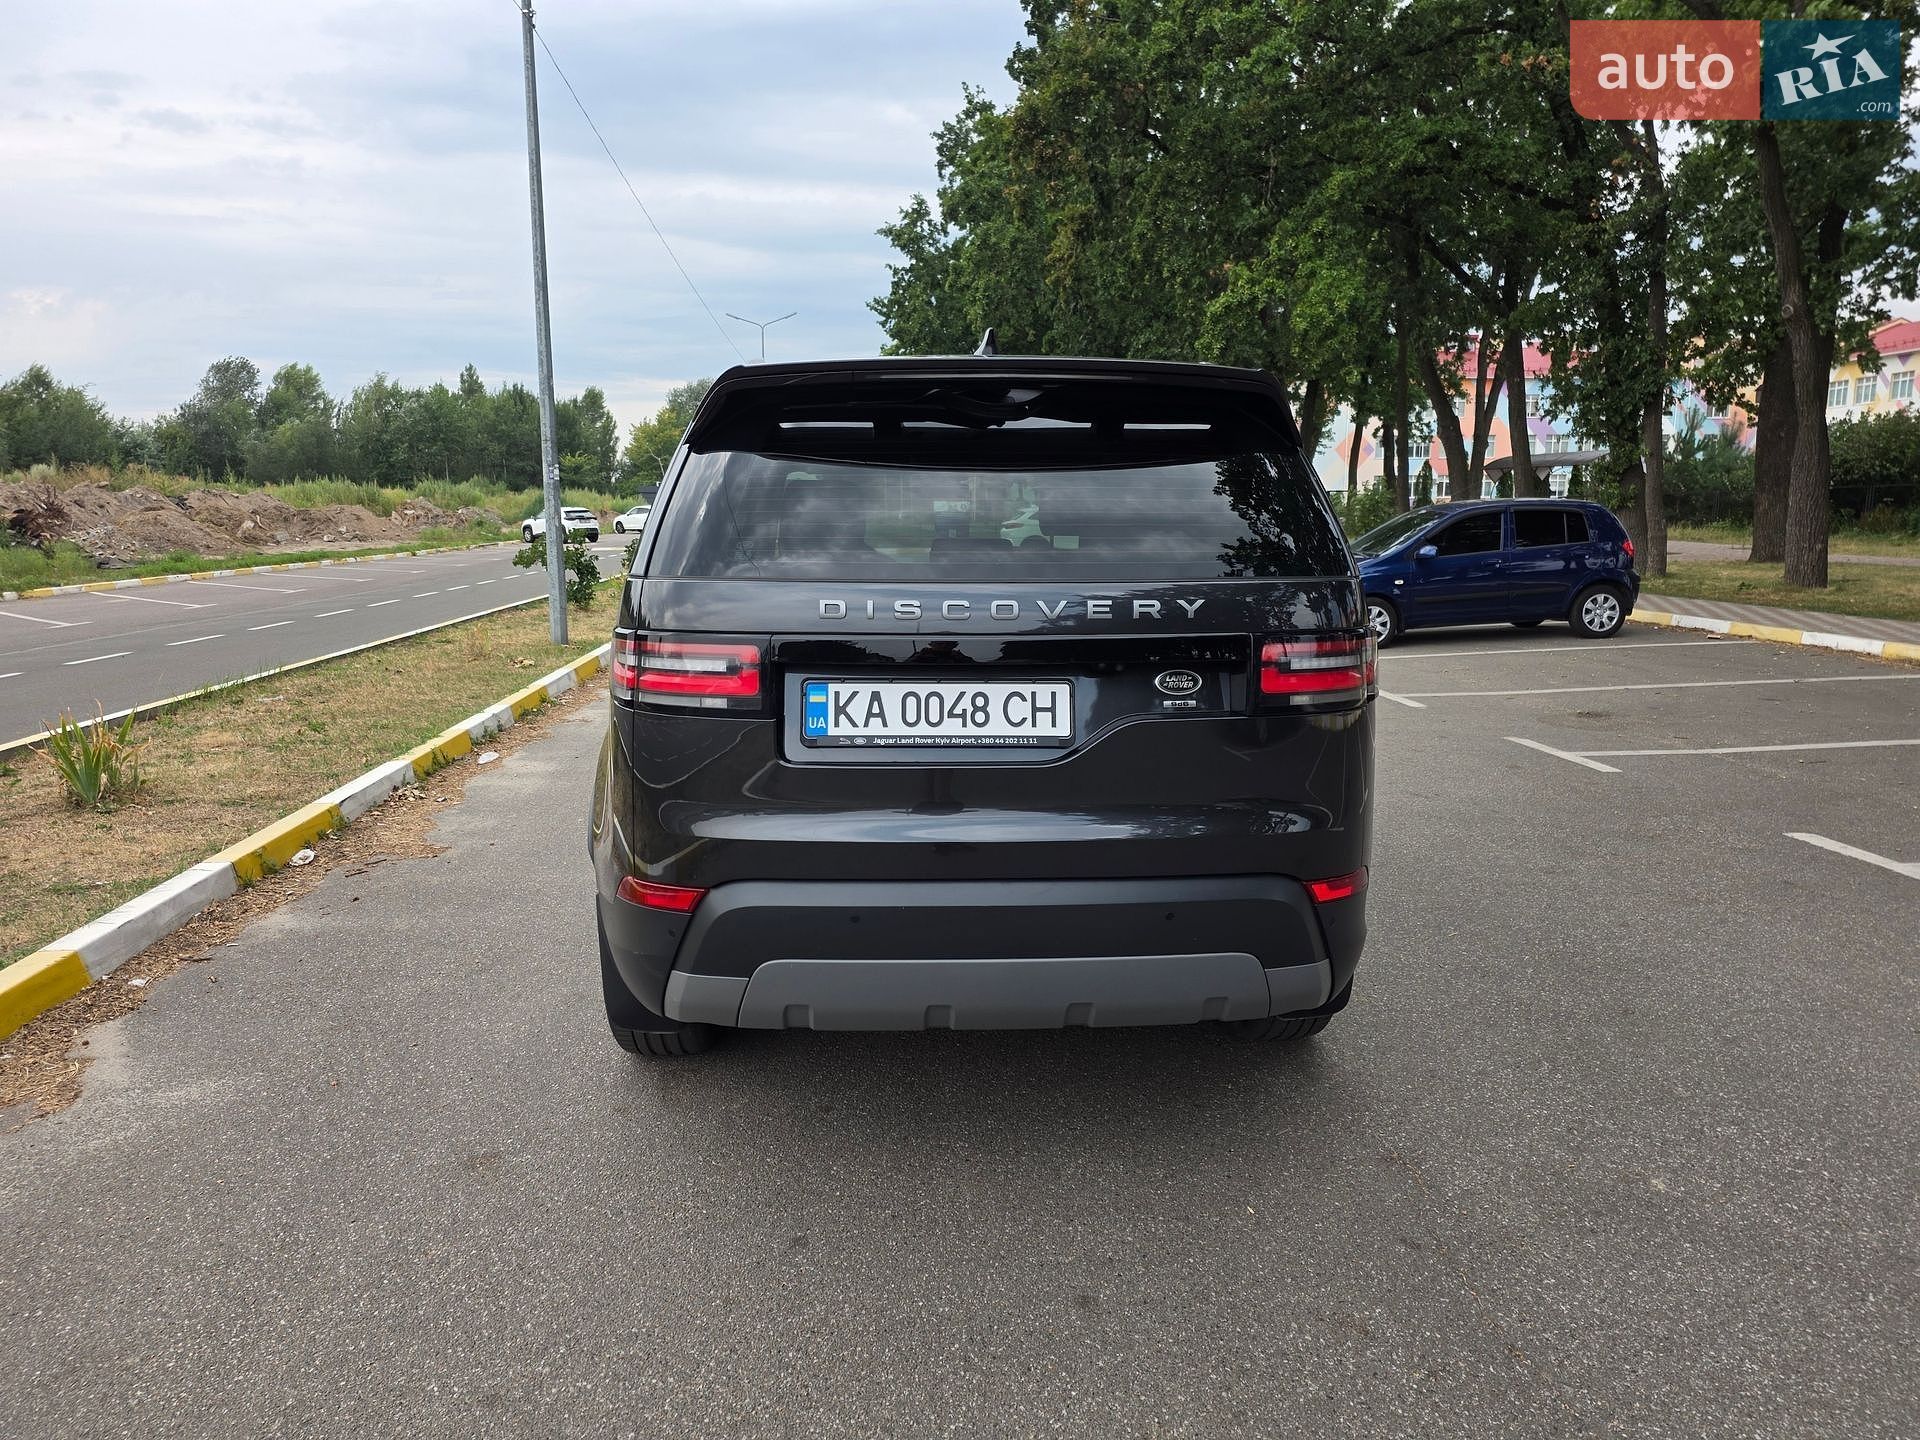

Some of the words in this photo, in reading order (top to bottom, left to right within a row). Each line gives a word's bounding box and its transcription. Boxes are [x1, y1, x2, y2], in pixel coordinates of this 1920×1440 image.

[818, 599, 1206, 621] DISCOVERY
[833, 690, 889, 728] KA
[901, 691, 990, 728] 0048
[1002, 691, 1057, 728] CH
[808, 717, 827, 729] UA
[873, 737, 896, 746] Jaguar
[935, 737, 950, 745] Kyiv
